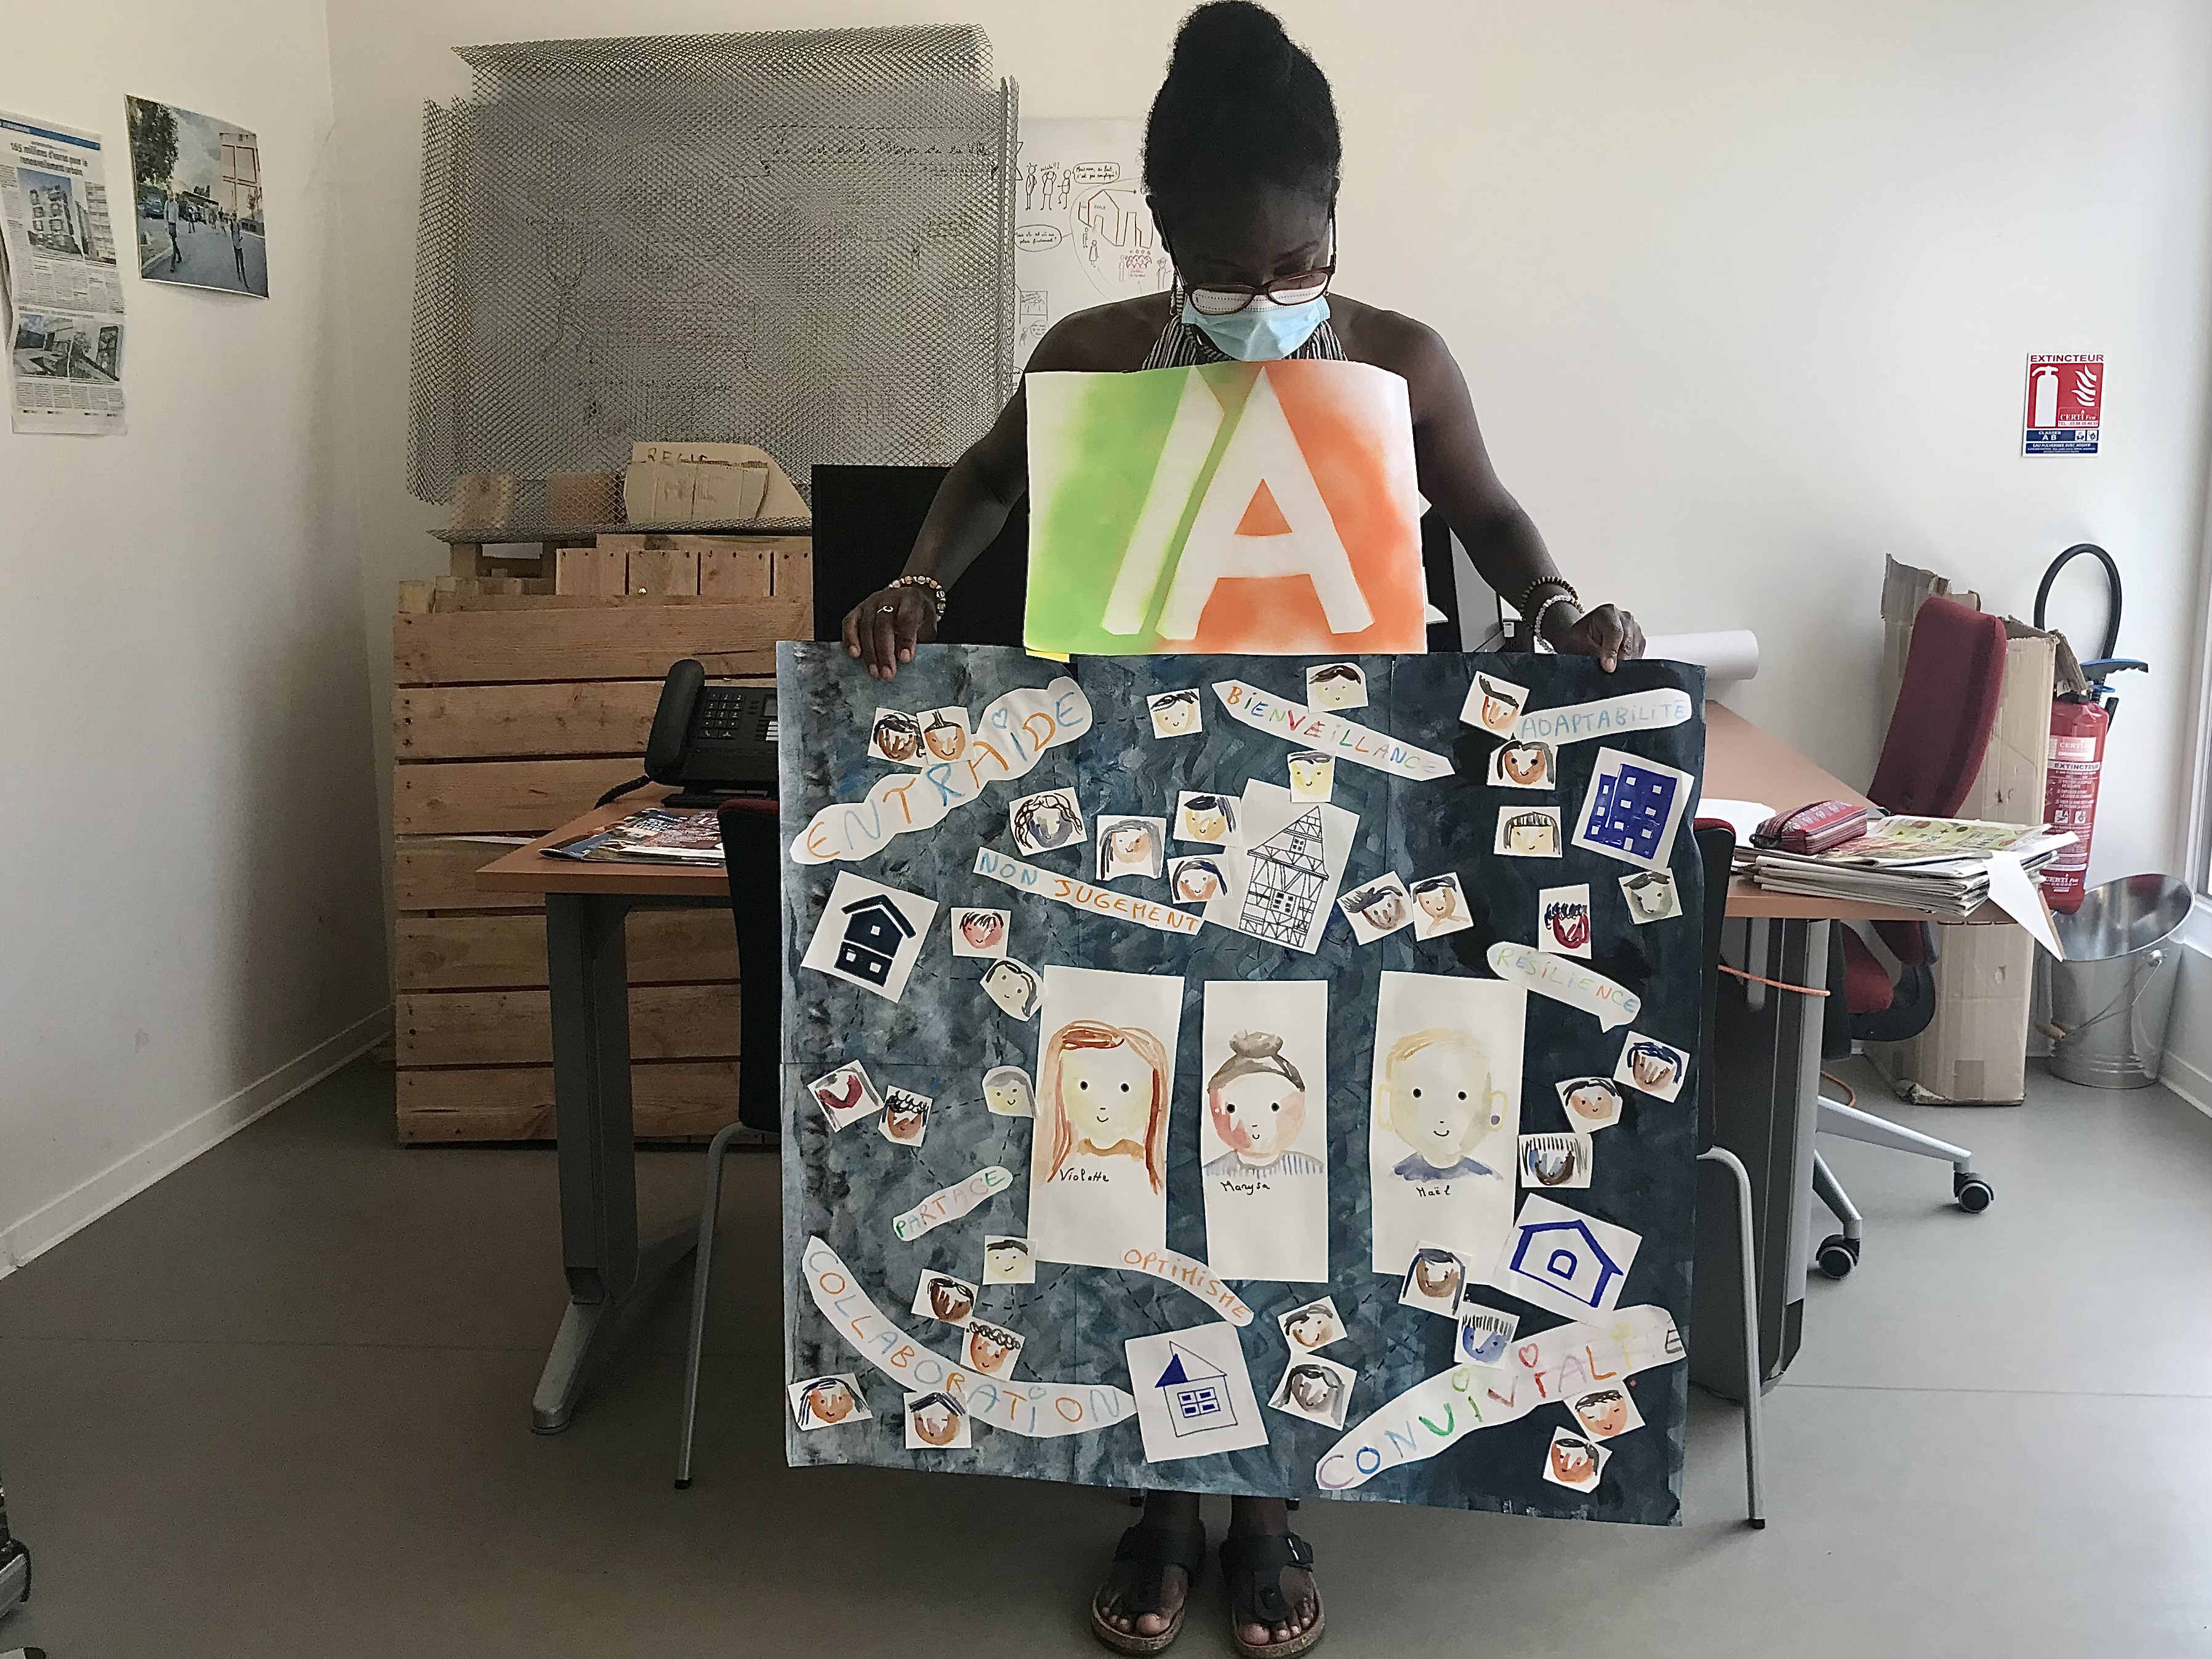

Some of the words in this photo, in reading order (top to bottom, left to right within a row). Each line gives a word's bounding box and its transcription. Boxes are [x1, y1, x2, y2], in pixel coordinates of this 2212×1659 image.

[806, 691, 1083, 858] ENTRAIDE
[979, 850, 1038, 886] NON
[1052, 877, 1199, 931] JUGEMENT
[896, 1169, 1006, 1237] PARTAGE
[1059, 1167, 1109, 1182] Violette
[1124, 1249, 1254, 1319] OPTIMISME
[807, 1249, 1120, 1434] COLLABORATION
[1316, 1317, 1685, 1489] CONVIVIALIÉ
